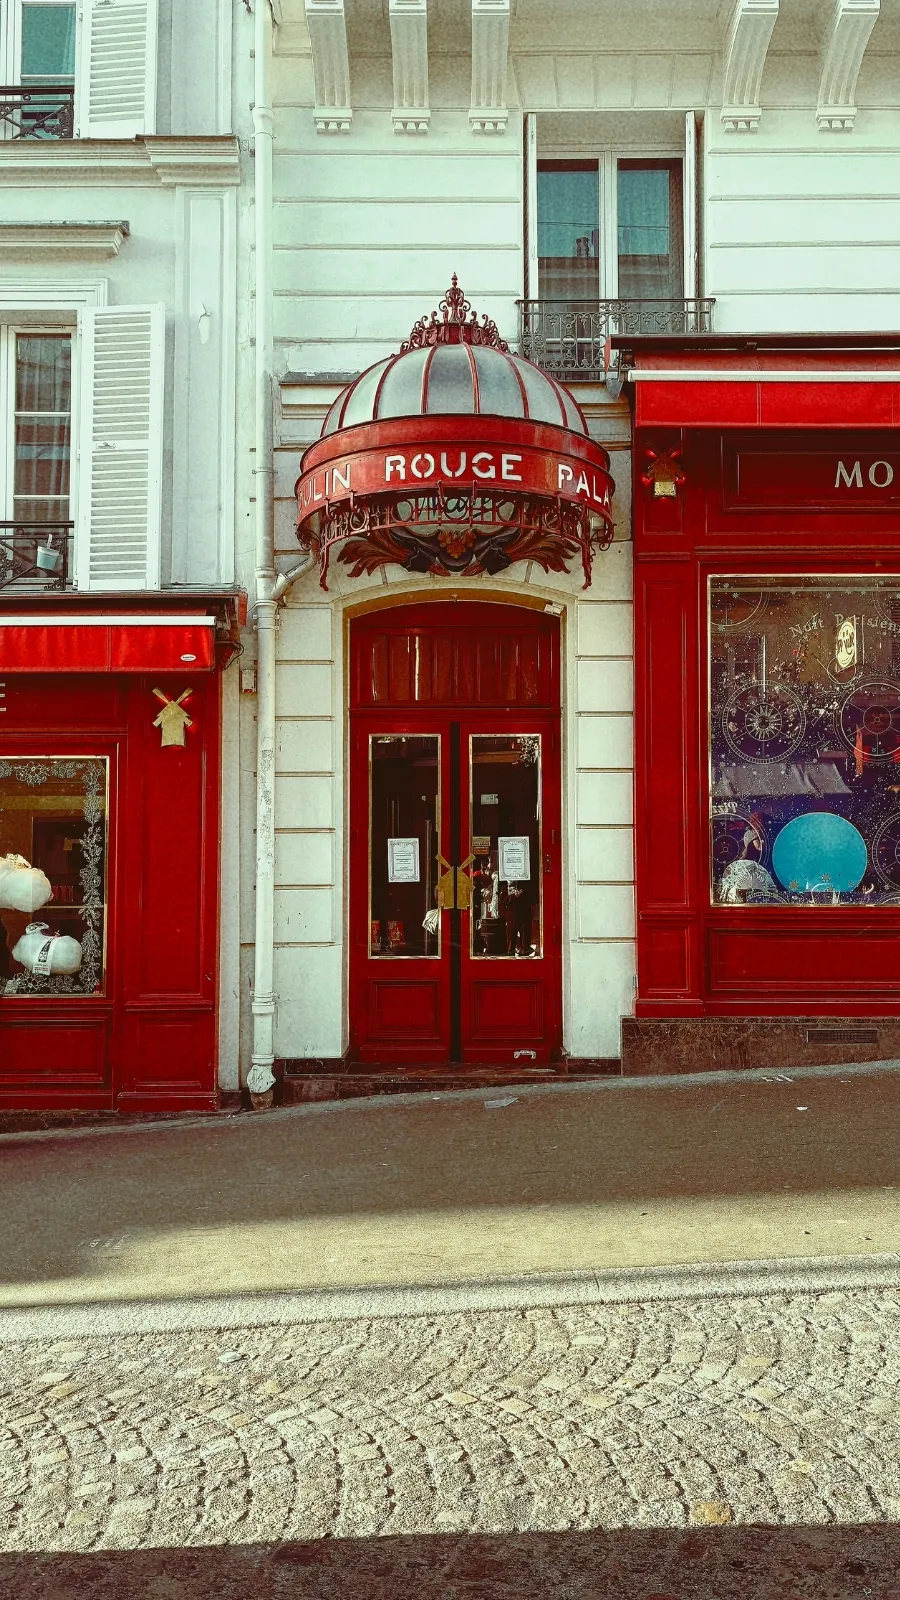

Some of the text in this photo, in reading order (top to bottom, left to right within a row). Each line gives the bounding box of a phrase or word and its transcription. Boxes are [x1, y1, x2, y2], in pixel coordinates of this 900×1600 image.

[300, 463, 351, 508] ULIN
[385, 452, 522, 481] ROUGE
[834, 460, 894, 488] MO
